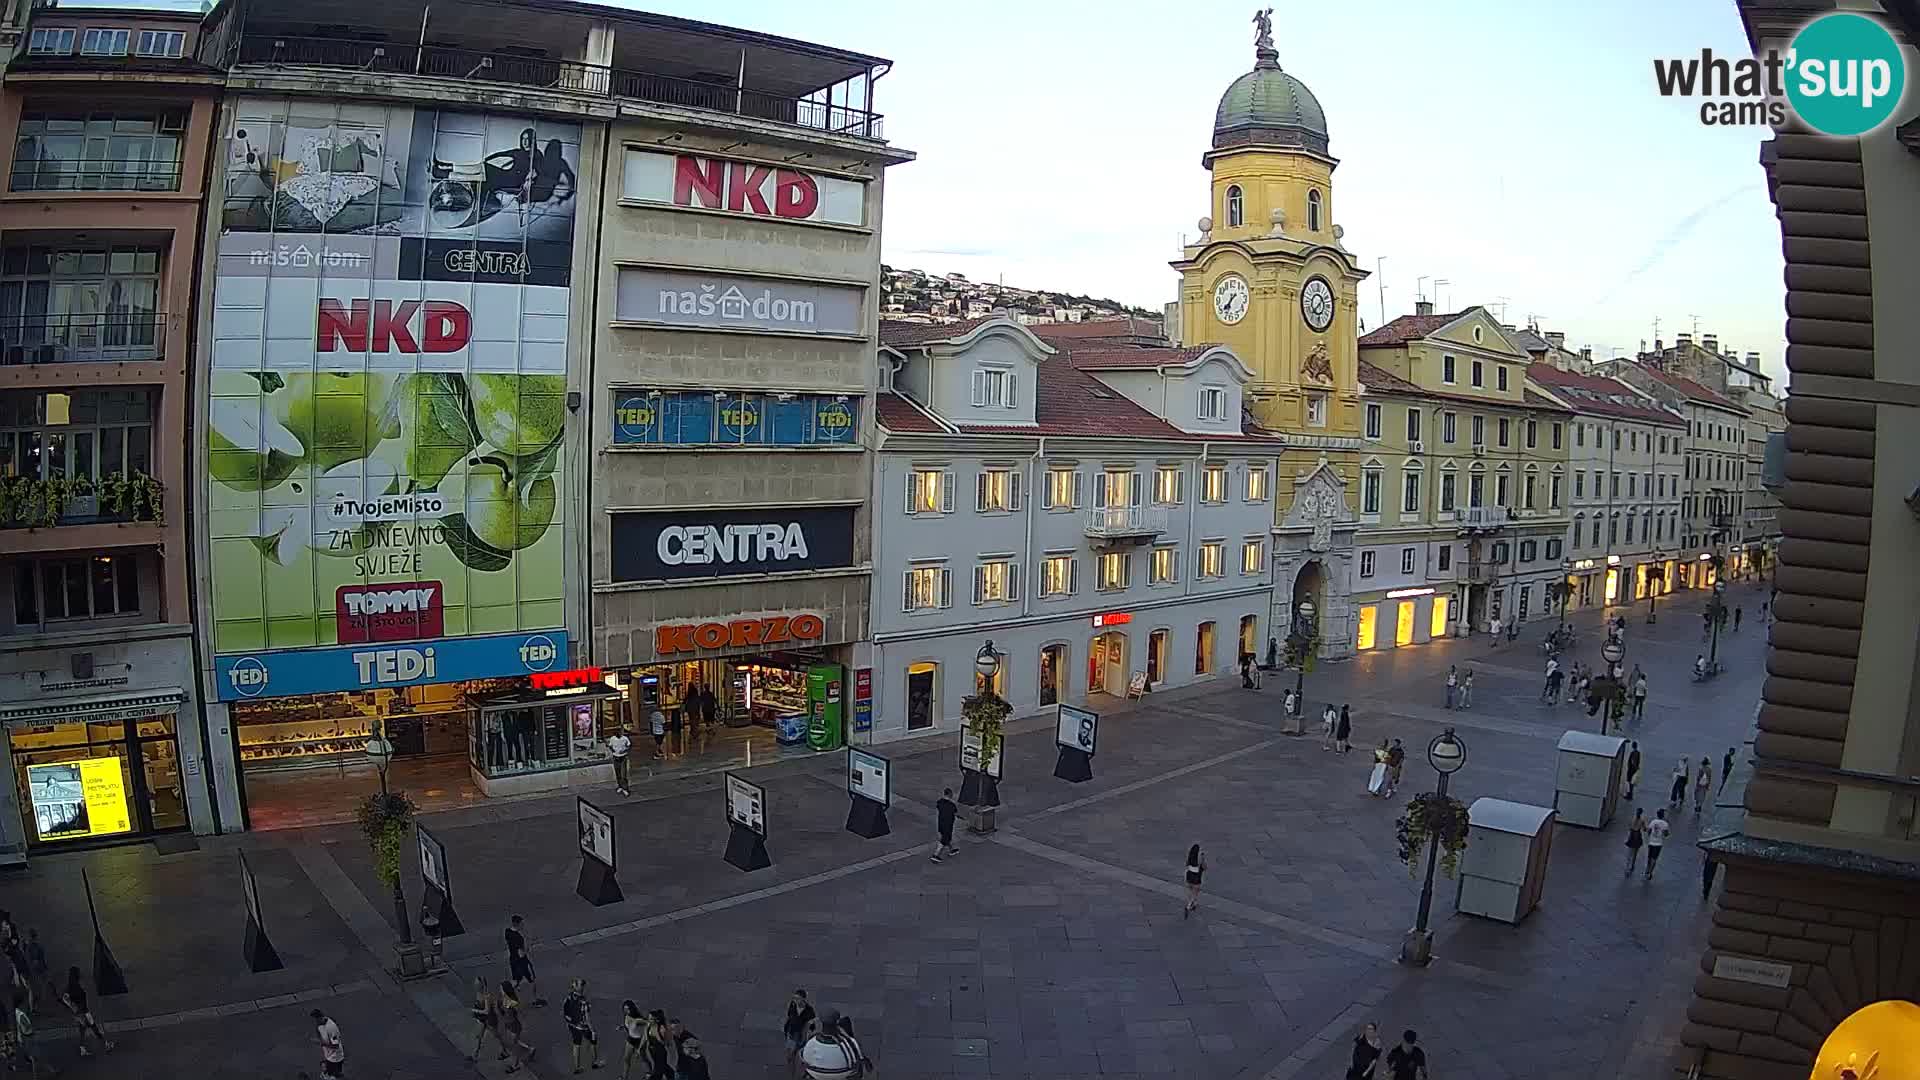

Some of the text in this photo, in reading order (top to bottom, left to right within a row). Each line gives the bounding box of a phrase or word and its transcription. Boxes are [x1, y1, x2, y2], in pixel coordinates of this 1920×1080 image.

[674, 155, 818, 219] NKD
[249, 244, 361, 268] naš dom
[444, 249, 531, 275] CENTRA
[659, 284, 815, 323] naš dom
[317, 298, 473, 354] NKD
[616, 408, 655, 426] TEDi
[721, 409, 758, 427] TEDi
[817, 411, 852, 428] TEDi
[333, 498, 442, 517] #TvojeMisto
[329, 524, 447, 550] ZA DNEVNO
[657, 522, 809, 566] CENTRA
[355, 548, 423, 577] SVJEŽE
[344, 588, 435, 616] TOMMY
[656, 614, 824, 655] KORZO
[518, 643, 557, 663] TEDi
[228, 667, 269, 685] TEDi
[352, 648, 437, 686] TEDi
